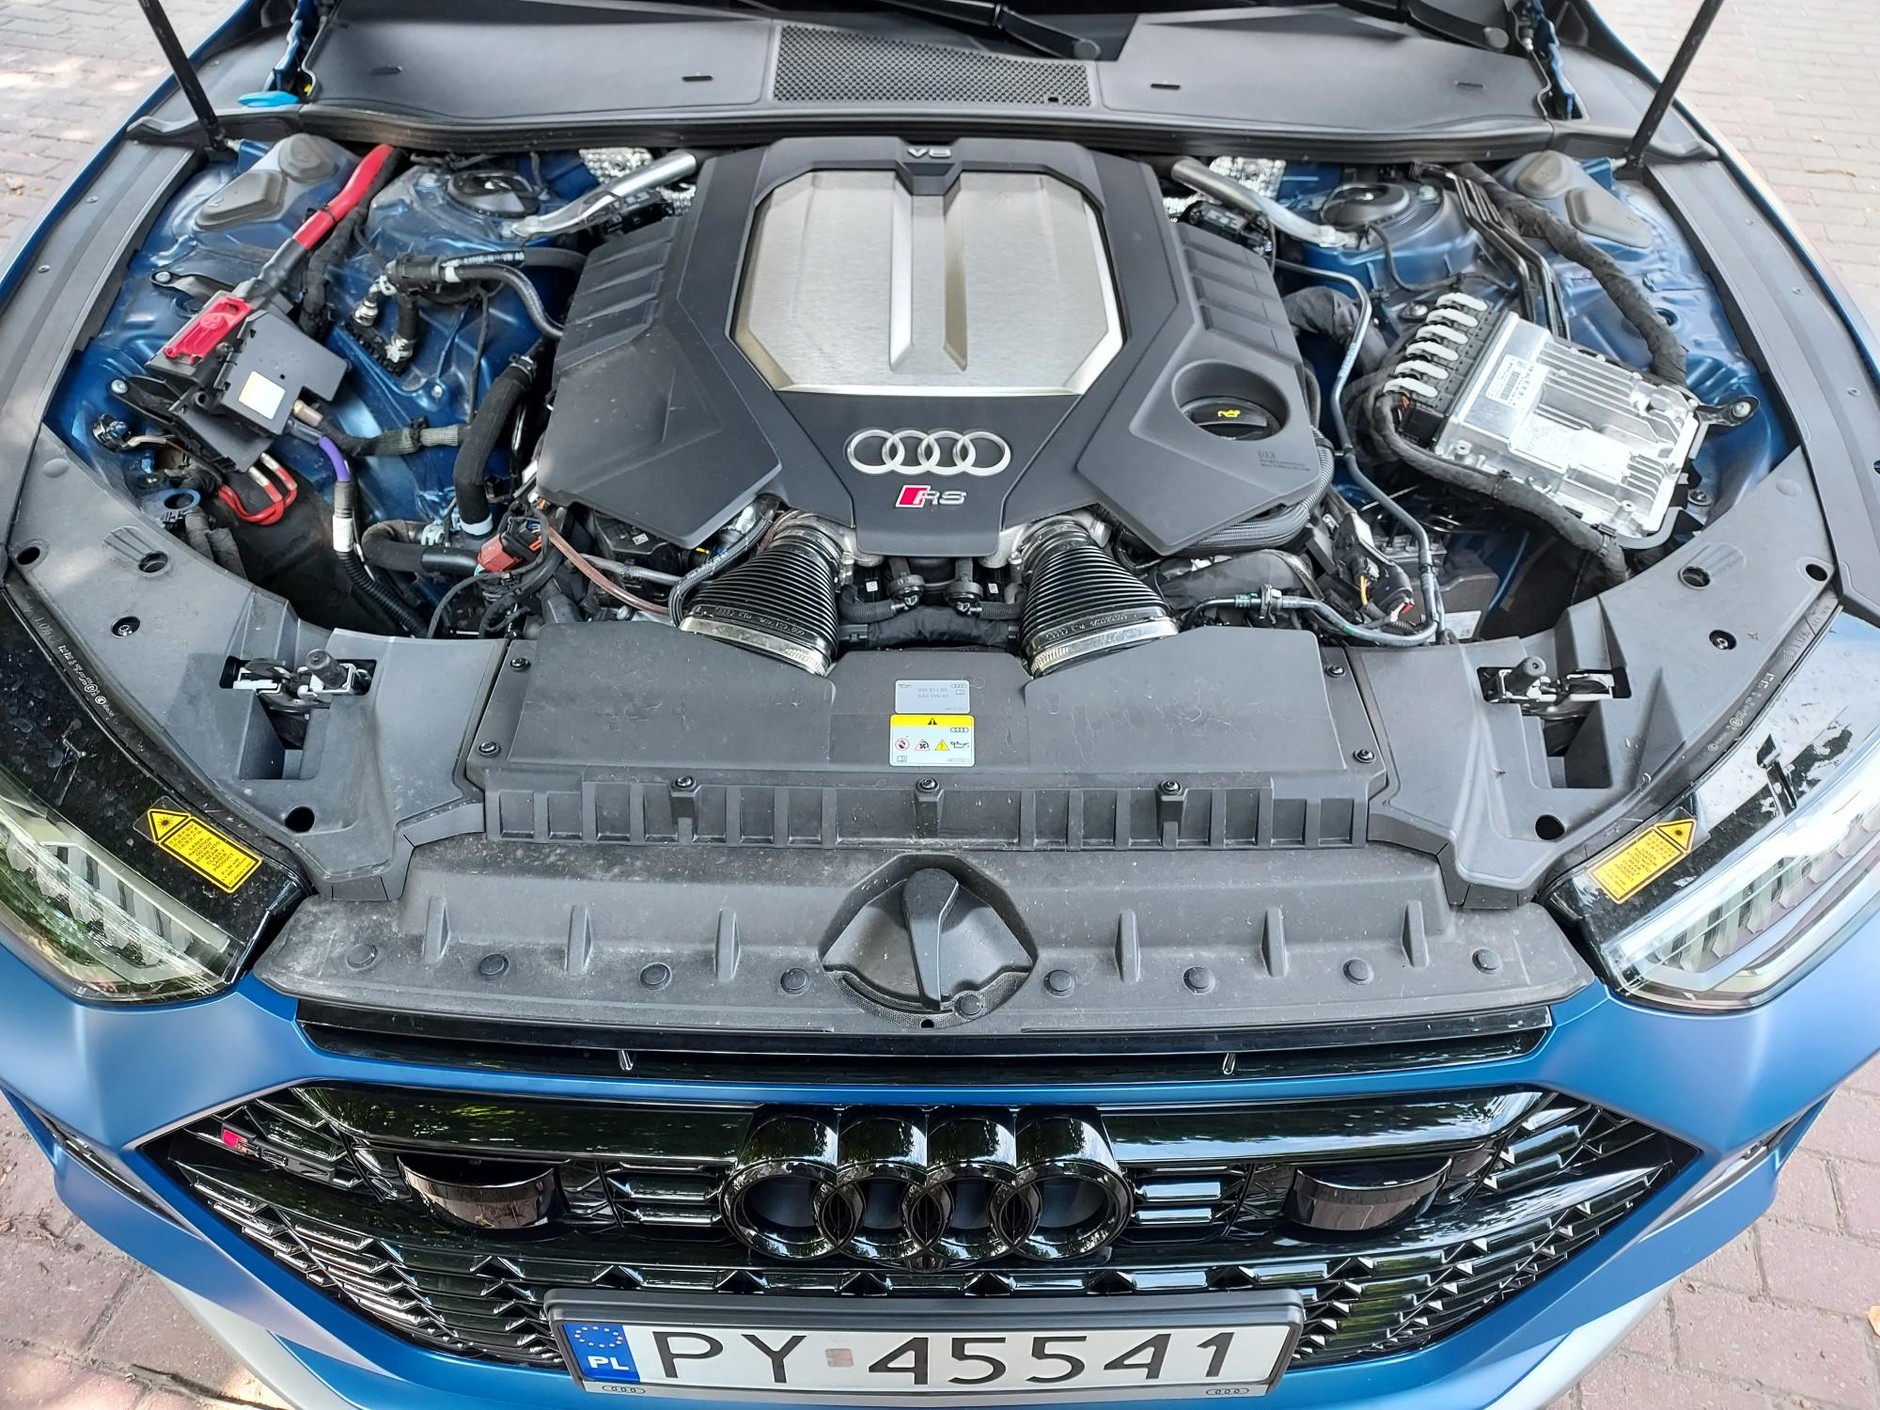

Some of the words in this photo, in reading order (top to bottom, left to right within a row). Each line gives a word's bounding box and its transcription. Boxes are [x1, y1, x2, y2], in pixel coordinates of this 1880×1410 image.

[907, 148, 952, 159] V8
[912, 490, 968, 505] RS
[587, 1355, 630, 1371] PL
[652, 1331, 807, 1383] PY
[868, 1332, 1234, 1385] 45541
